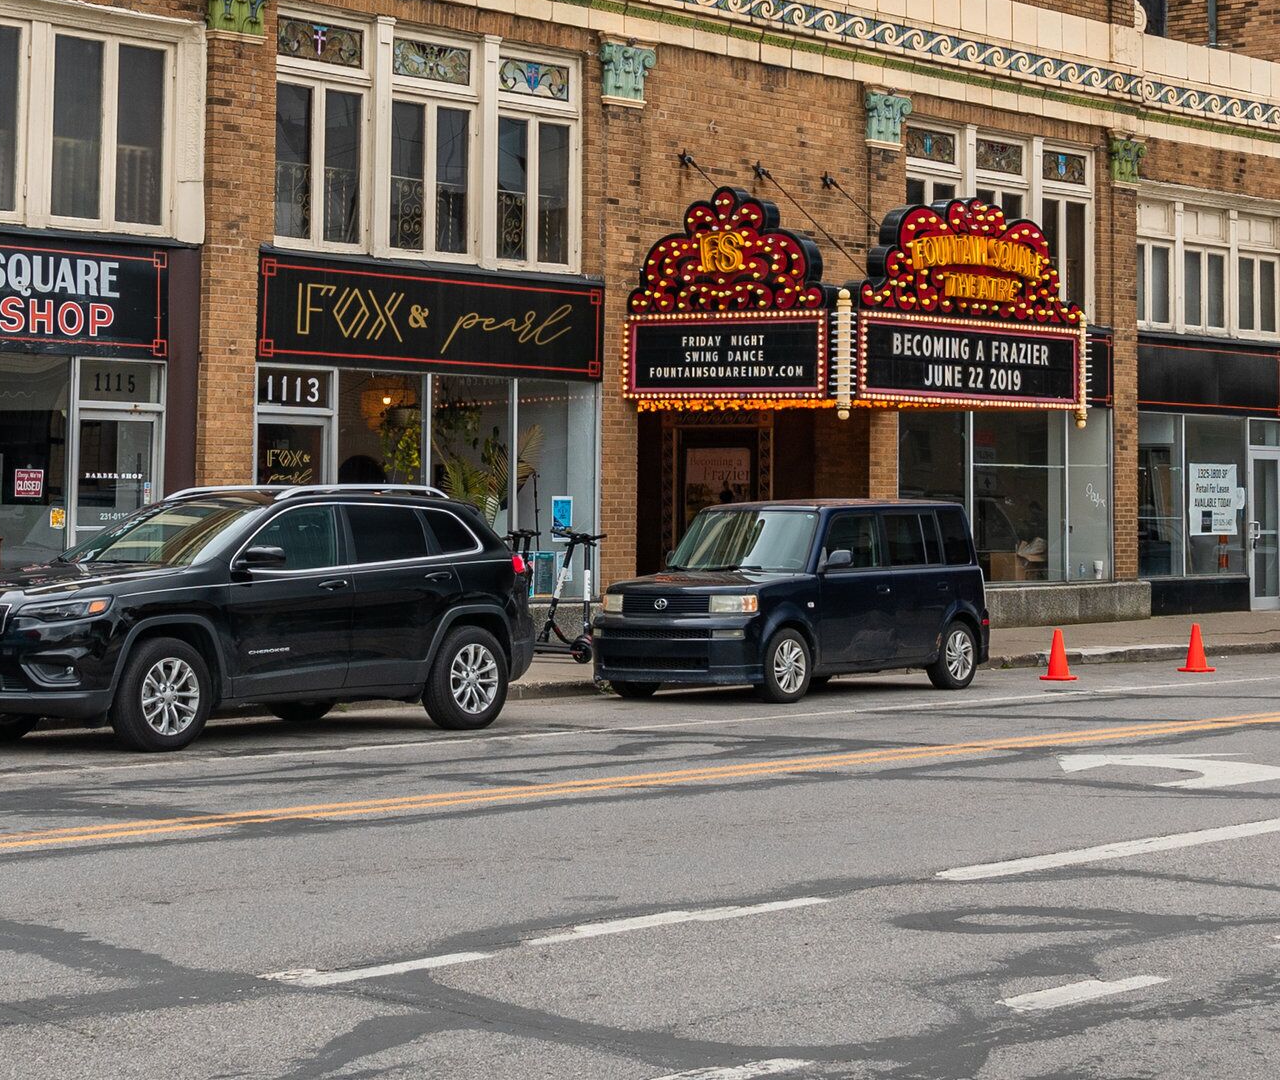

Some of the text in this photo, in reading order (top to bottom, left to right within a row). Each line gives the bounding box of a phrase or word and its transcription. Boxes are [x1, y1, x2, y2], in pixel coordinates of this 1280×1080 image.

[699, 231, 745, 273] FS
[911, 236, 1044, 281] FOUNTAIN SQUARE
[943, 271, 1019, 303] THEATRE
[297, 282, 572, 354] FOX & pearl
[682, 335, 765, 347] FRIDAY NIGHT
[892, 332, 1049, 366] BECOMING A FRAZIER
[685, 350, 765, 363] SWING DANCE
[649, 365, 804, 378] FOUNTAINSQUAREINDY.COM
[924, 364, 1022, 391] JUNE 22 2019
[94, 372, 136, 394] 1115
[267, 375, 320, 403] 1113
[266, 449, 311, 467] FOX &
[690, 456, 733, 467] Becoming
[266, 468, 313, 485] pearl
[703, 467, 749, 481] Frazier
[16, 480, 41, 491] CLOSED
[1217, 483, 1230, 493] Lease
[1195, 498, 1231, 507] AVAILABLE TODAY
[248, 646, 290, 655] CHEROKEE
